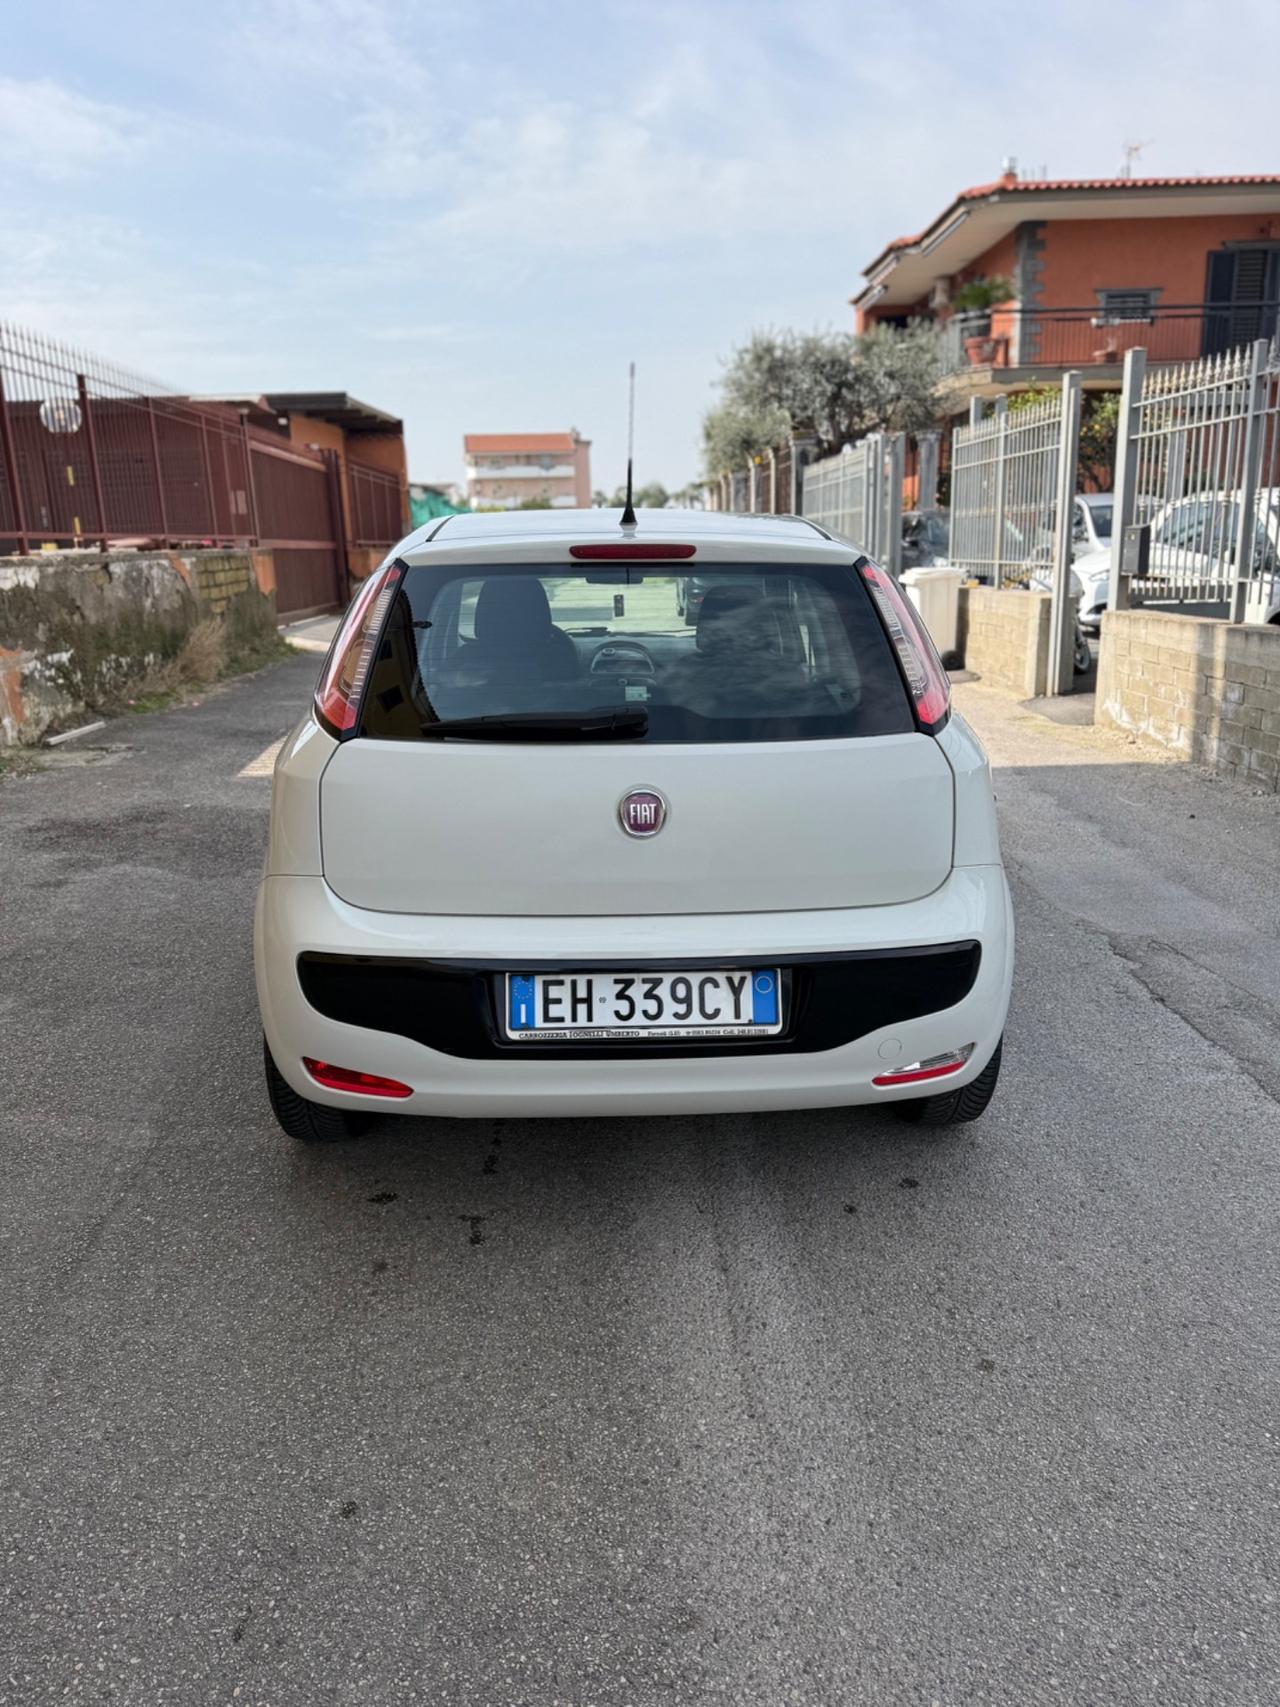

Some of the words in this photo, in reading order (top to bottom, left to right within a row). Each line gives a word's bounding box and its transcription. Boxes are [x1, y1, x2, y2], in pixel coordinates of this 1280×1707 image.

[629, 803, 657, 825] FIAT
[542, 979, 593, 1023] EH
[613, 976, 748, 1021] 339CY
